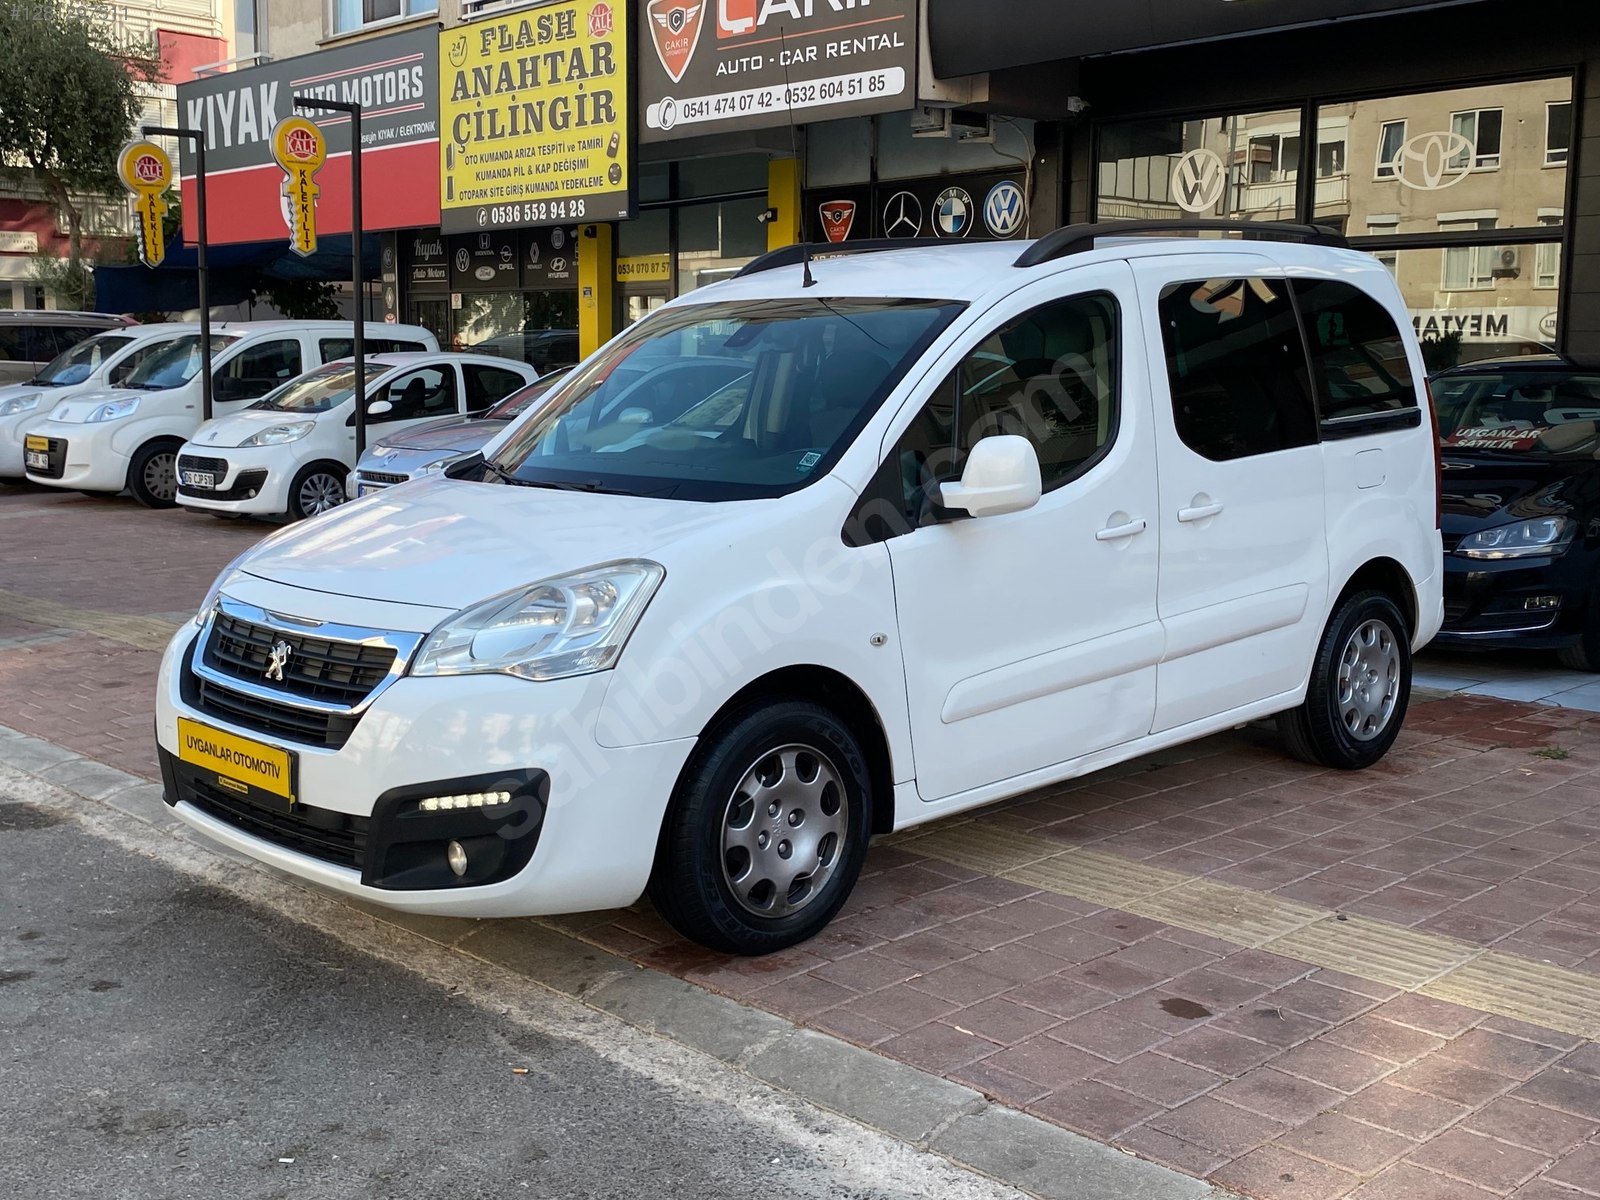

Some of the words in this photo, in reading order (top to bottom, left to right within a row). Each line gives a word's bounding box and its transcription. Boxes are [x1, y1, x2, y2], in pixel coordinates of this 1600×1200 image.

[480, 9, 576, 56] FLASH
[588, 13, 613, 35] KALE
[715, 55, 763, 76] AUTO
[780, 46, 817, 66] CAR
[826, 31, 904, 59] RENTAL
[450, 41, 616, 102] ANAHTAR
[683, 100, 710, 118] 0541
[714, 96, 735, 114] 474
[739, 93, 754, 110] 07
[757, 91, 773, 108] 42
[784, 85, 815, 105] 0532
[819, 81, 843, 99] 604
[848, 78, 863, 94] 51
[869, 74, 885, 92] 85
[187, 81, 279, 153] KIYAK
[292, 83, 337, 118] AUTO
[342, 65, 424, 107] MOTORS
[452, 83, 617, 154] ÇİLİNGİR
[286, 136, 318, 156] KALE
[378, 127, 395, 141] KIYAK
[465, 155, 478, 166] OTO
[480, 151, 513, 164] KUMANDA
[515, 146, 536, 159] ARIZA
[538, 140, 565, 156] TESPİTİ
[567, 144, 575, 152] ve
[577, 137, 603, 150] TAMİRİ
[135, 161, 164, 179] KALE
[475, 168, 512, 182] KUMANDA
[514, 165, 525, 178] PİL
[528, 165, 533, 175] &
[535, 162, 551, 174] KAP
[553, 158, 589, 174] DEĞİŞİMİ
[459, 187, 488, 201] OTOPARK
[490, 183, 504, 197] SİTE
[506, 181, 523, 196] GİRİŞ
[525, 180, 559, 194] KUMANDA
[561, 175, 604, 189] YEDEKLEME
[492, 204, 520, 224] 0536
[524, 202, 546, 221] 552
[550, 200, 566, 219] 94
[570, 199, 585, 217] 28
[413, 267, 427, 280] Auto
[428, 267, 445, 279] Motors
[617, 263, 635, 275] 0534
[636, 262, 649, 274] 070
[651, 262, 661, 273] 87
[661, 261, 670, 272] 57
[1456, 428, 1541, 438] UYGANLAR
[1456, 439, 1518, 449] SATILIK
[187, 735, 233, 763] UYGANLAR
[233, 751, 280, 779] OTOMOTİV
